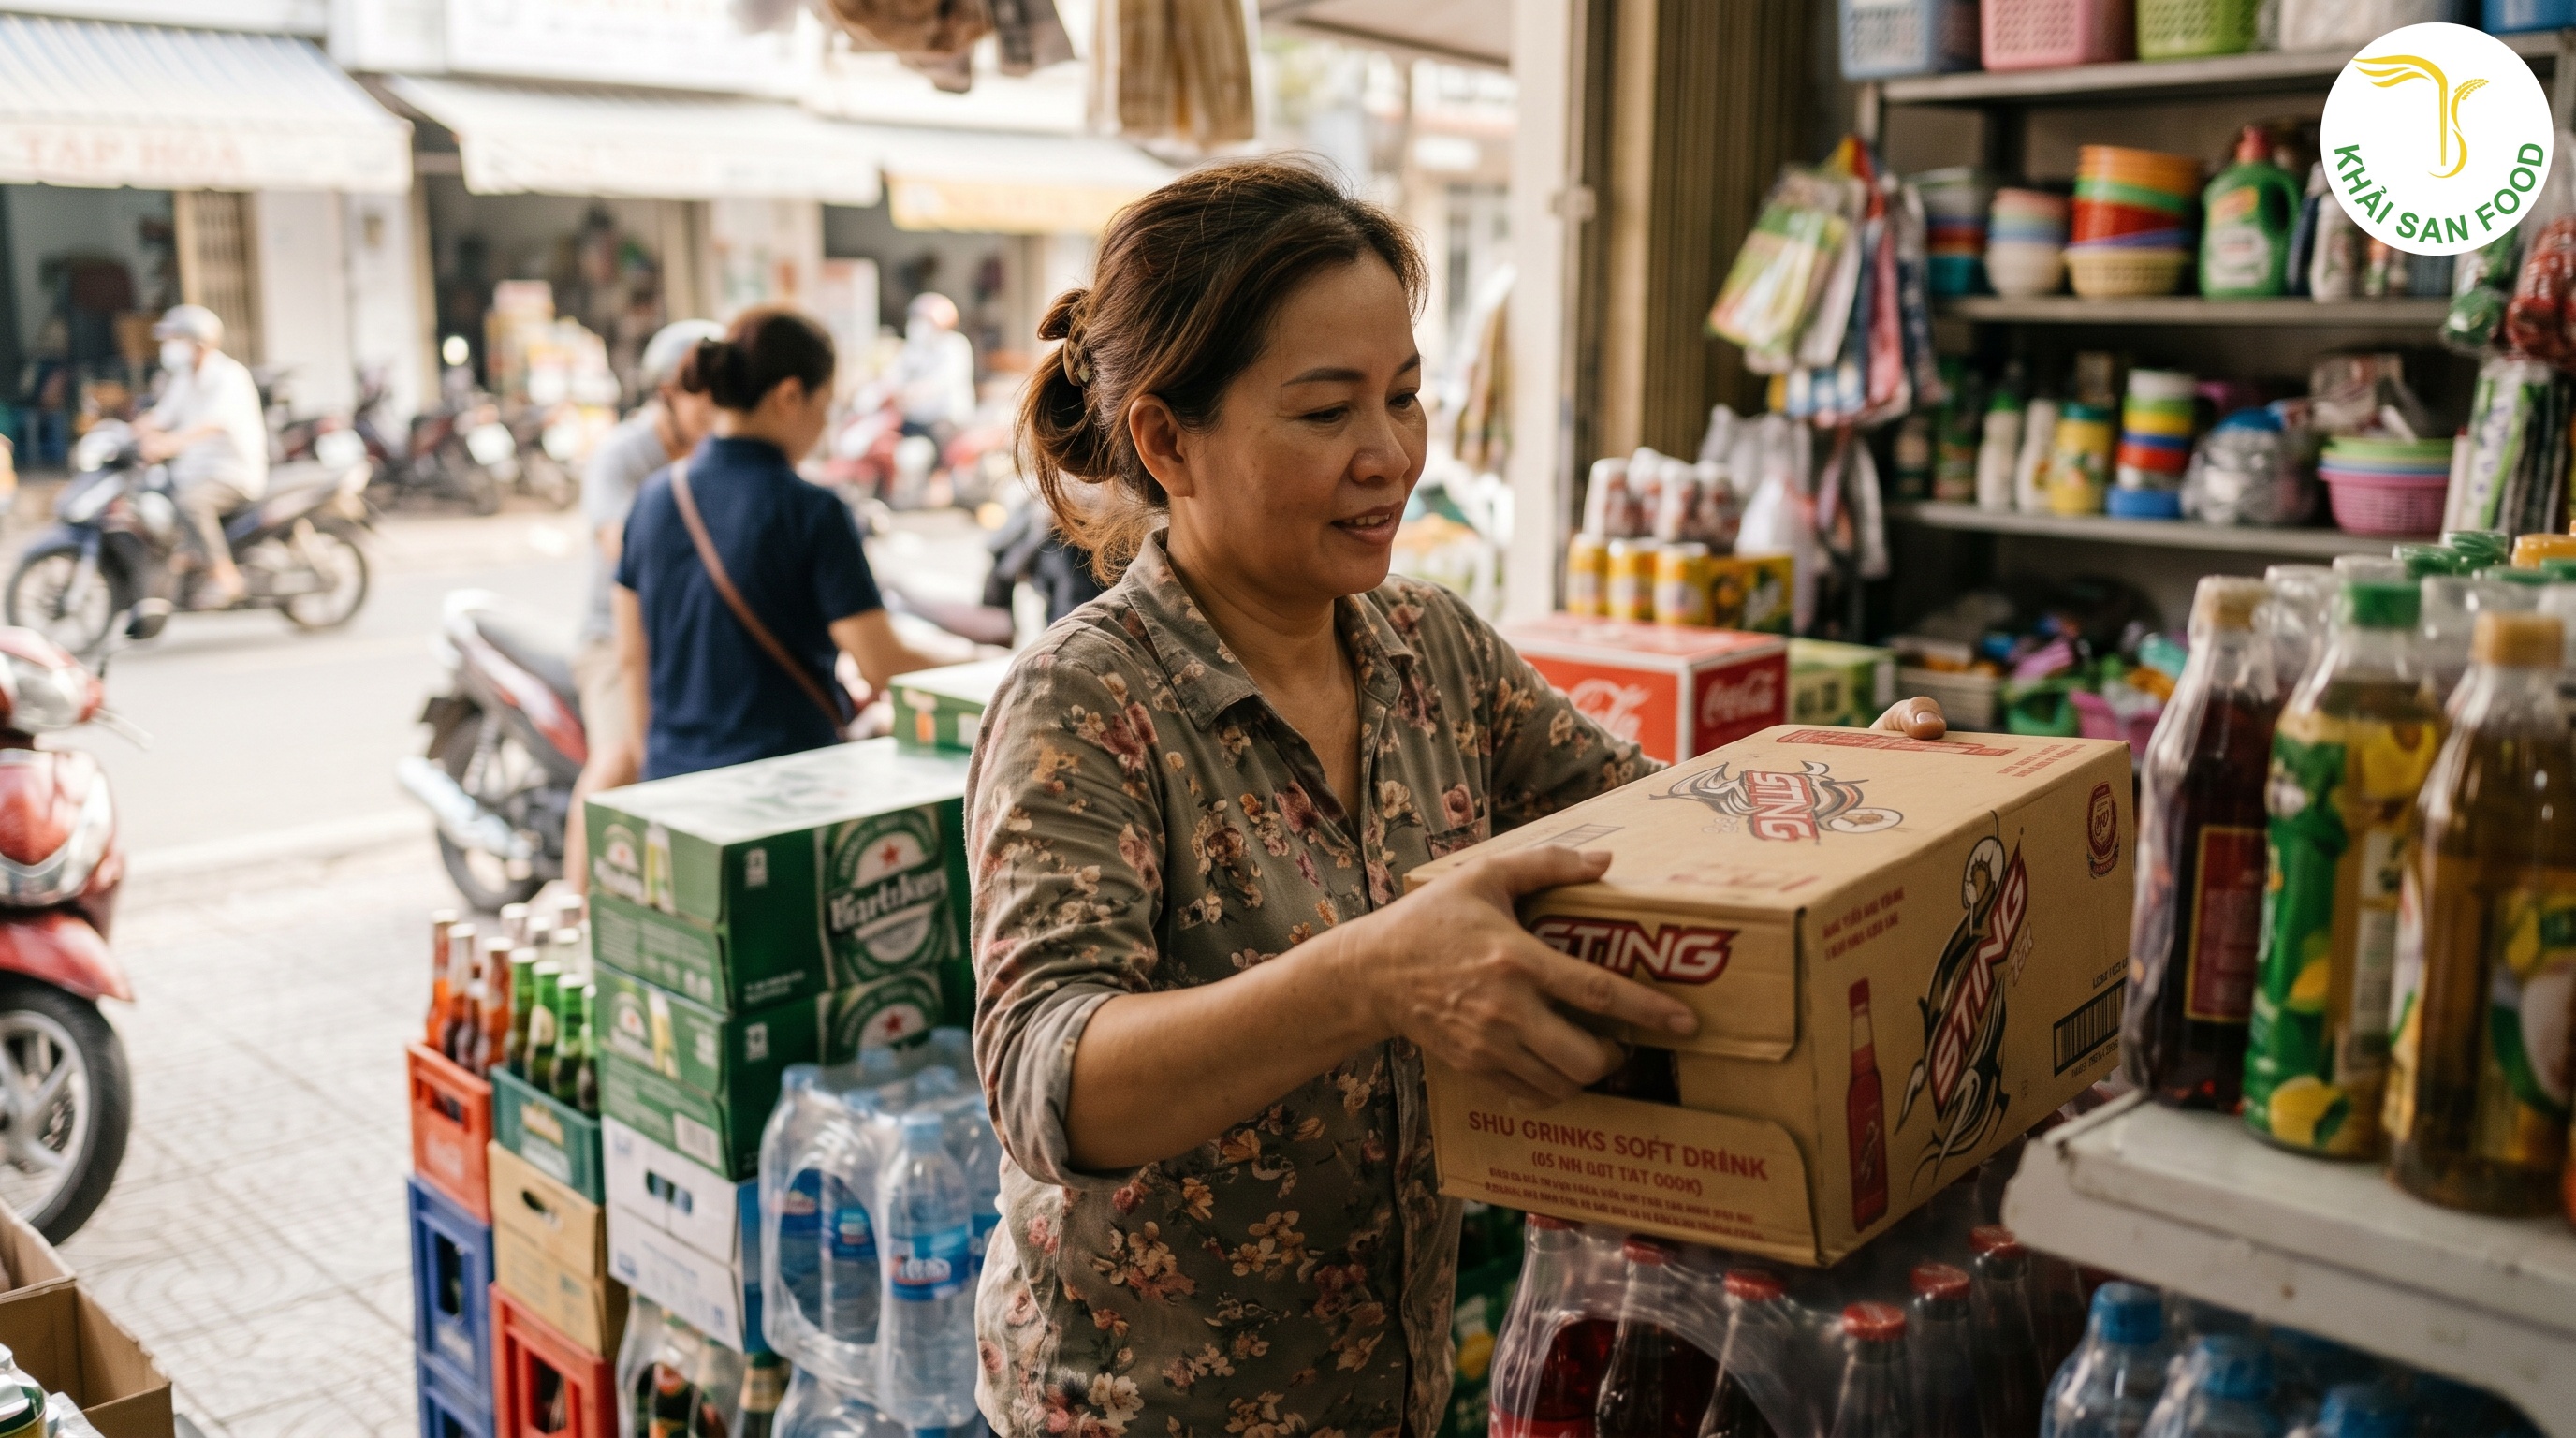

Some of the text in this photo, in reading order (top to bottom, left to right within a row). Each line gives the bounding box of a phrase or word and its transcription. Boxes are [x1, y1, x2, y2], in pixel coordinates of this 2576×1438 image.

[1749, 770, 1814, 840] STING
[1932, 857, 2027, 1108] STING
[1468, 1111, 1515, 1137] SHU
[1521, 1119, 1606, 1152] GRINKS
